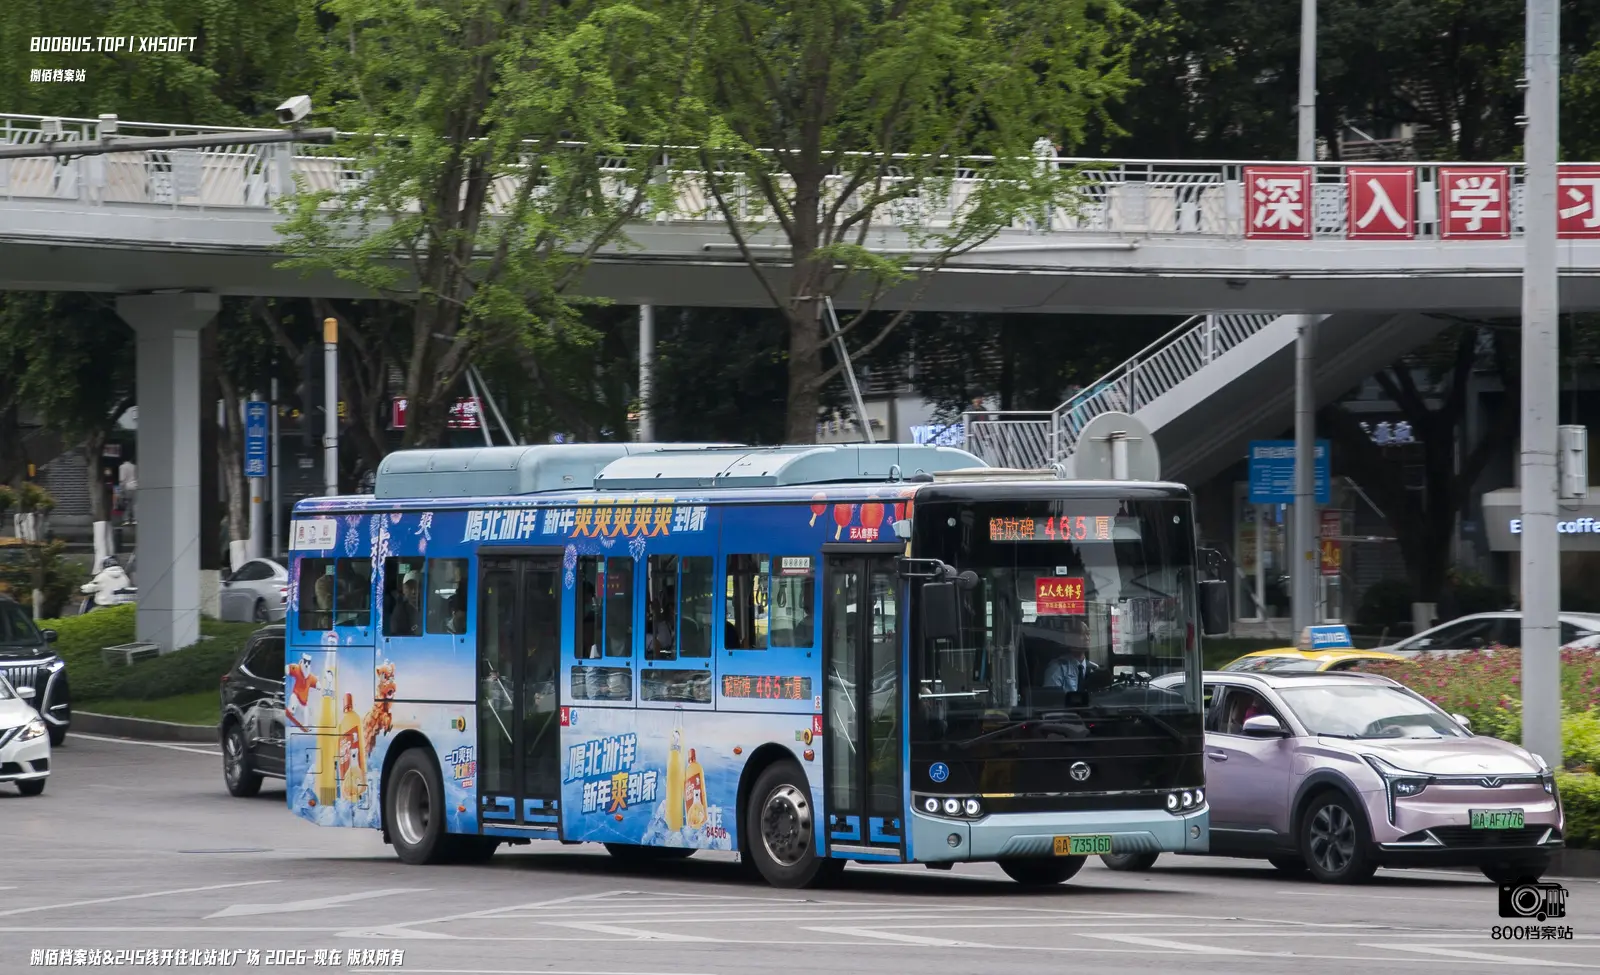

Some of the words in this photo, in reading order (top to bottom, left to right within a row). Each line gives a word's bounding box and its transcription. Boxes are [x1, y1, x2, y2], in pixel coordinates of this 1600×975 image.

[246, 406, 265, 473] 中山三路
[461, 503, 538, 543] 喝北冰洋
[850, 527, 879, 539] 无人售票车
[990, 517, 1035, 541] 解放碑
[1045, 515, 1087, 541] 465
[1038, 583, 1082, 599] 工人先锋号
[756, 675, 781, 699] 465
[784, 676, 803, 700] 大厦
[563, 733, 636, 784] 喝北冰洋
[581, 769, 658, 814] 新年爽到家
[1489, 812, 1523, 826] AF7776
[706, 826, 727, 839] 84506
[1073, 837, 1111, 852] 73516D
